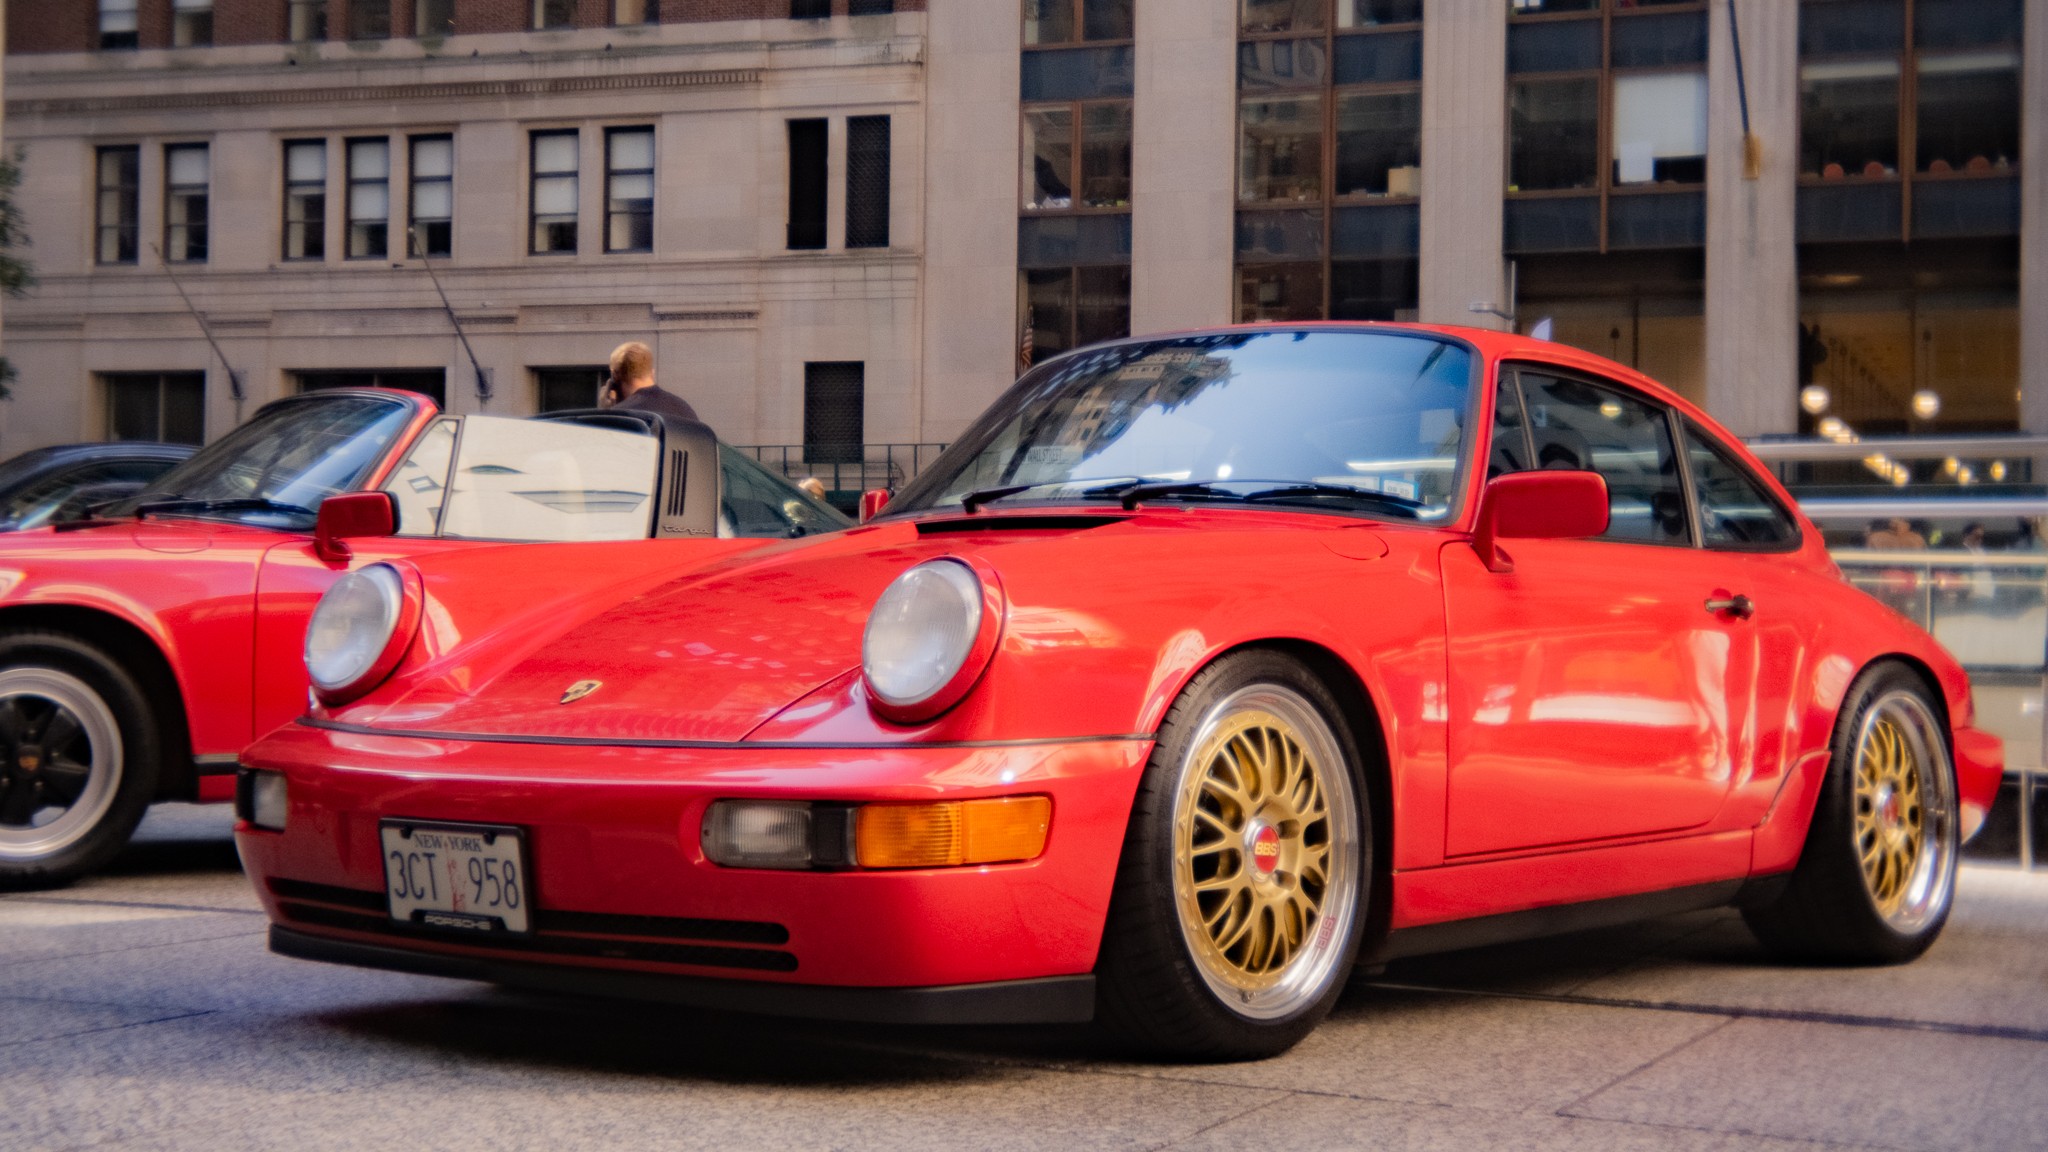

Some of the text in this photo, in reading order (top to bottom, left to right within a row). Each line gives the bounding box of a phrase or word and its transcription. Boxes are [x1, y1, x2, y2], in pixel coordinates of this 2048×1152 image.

[414, 834, 482, 852] NEW YORK
[1254, 842, 1277, 856] BBS
[390, 850, 520, 909] 3CT 958
[424, 915, 491, 930] PORSCHE
[1316, 915, 1336, 949] BBS
